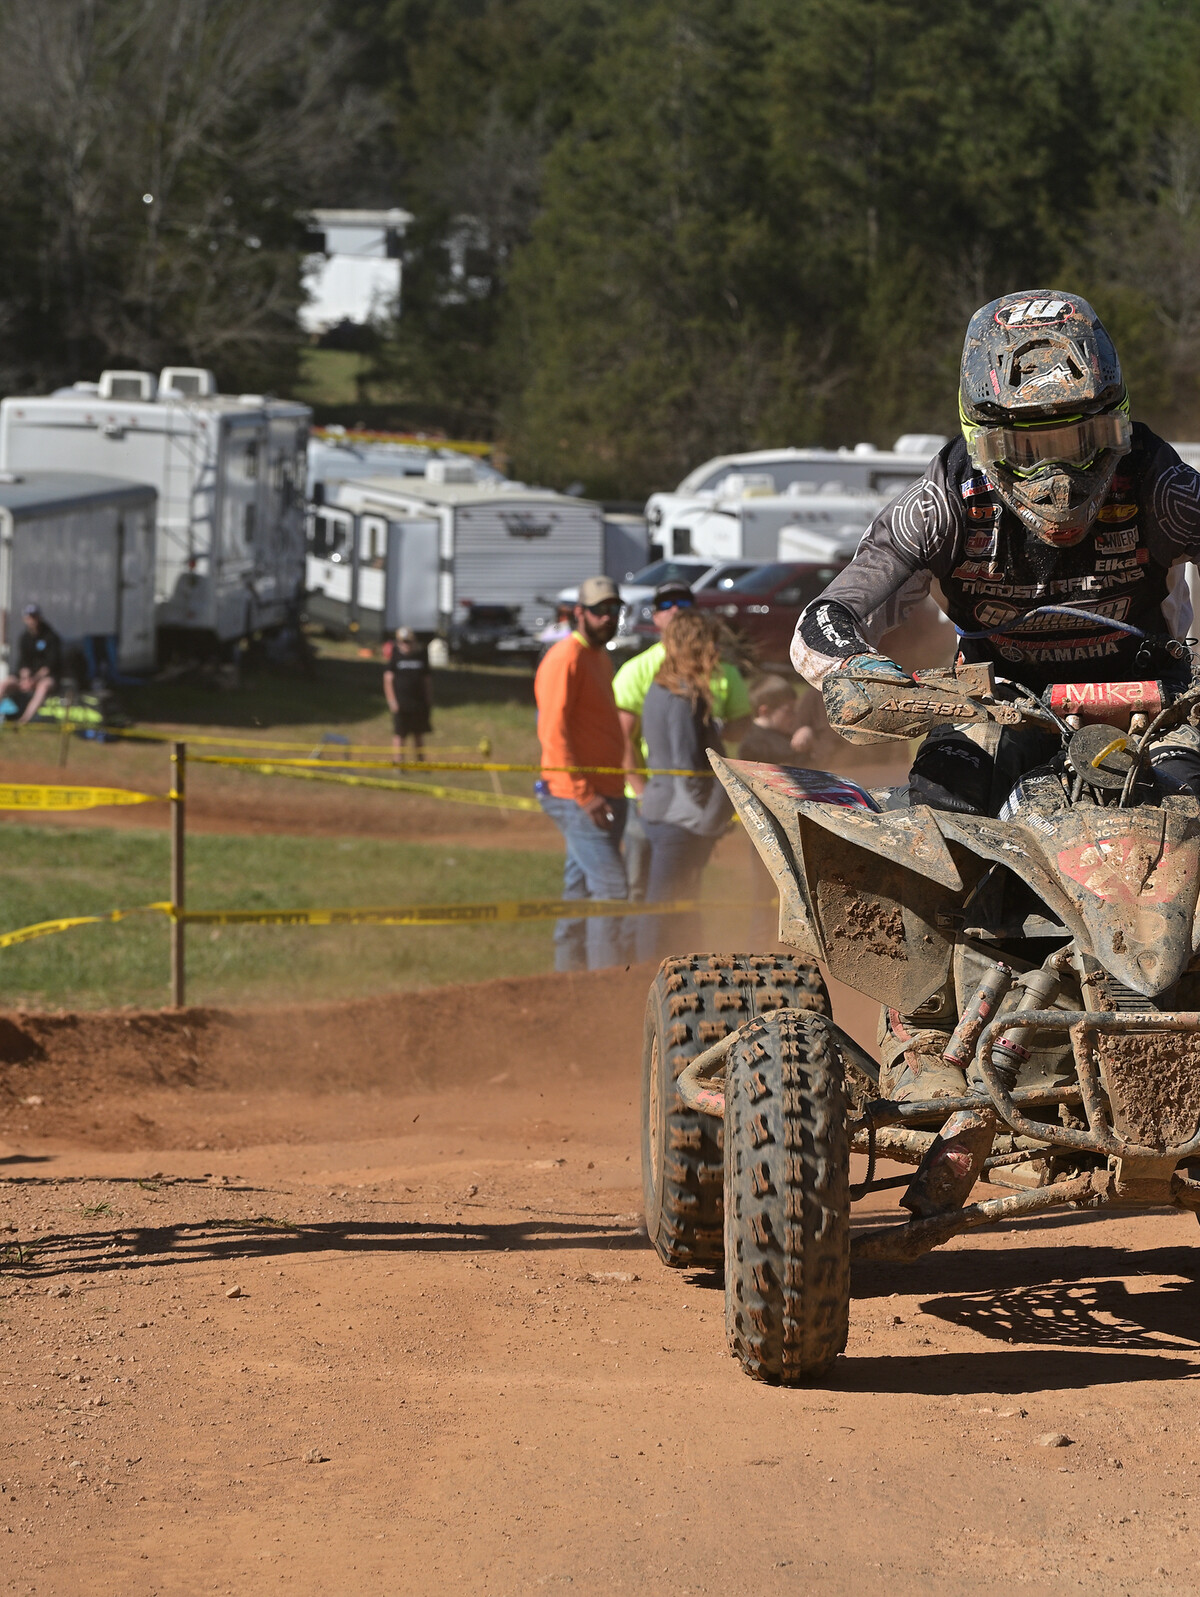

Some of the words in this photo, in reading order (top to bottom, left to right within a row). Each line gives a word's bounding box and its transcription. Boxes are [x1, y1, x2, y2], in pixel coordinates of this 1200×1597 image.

[1095, 558, 1137, 572] Elka
[1051, 568, 1144, 594] RACING
[1026, 641, 1119, 662] YAMAHA
[1065, 683, 1143, 704] Mika
